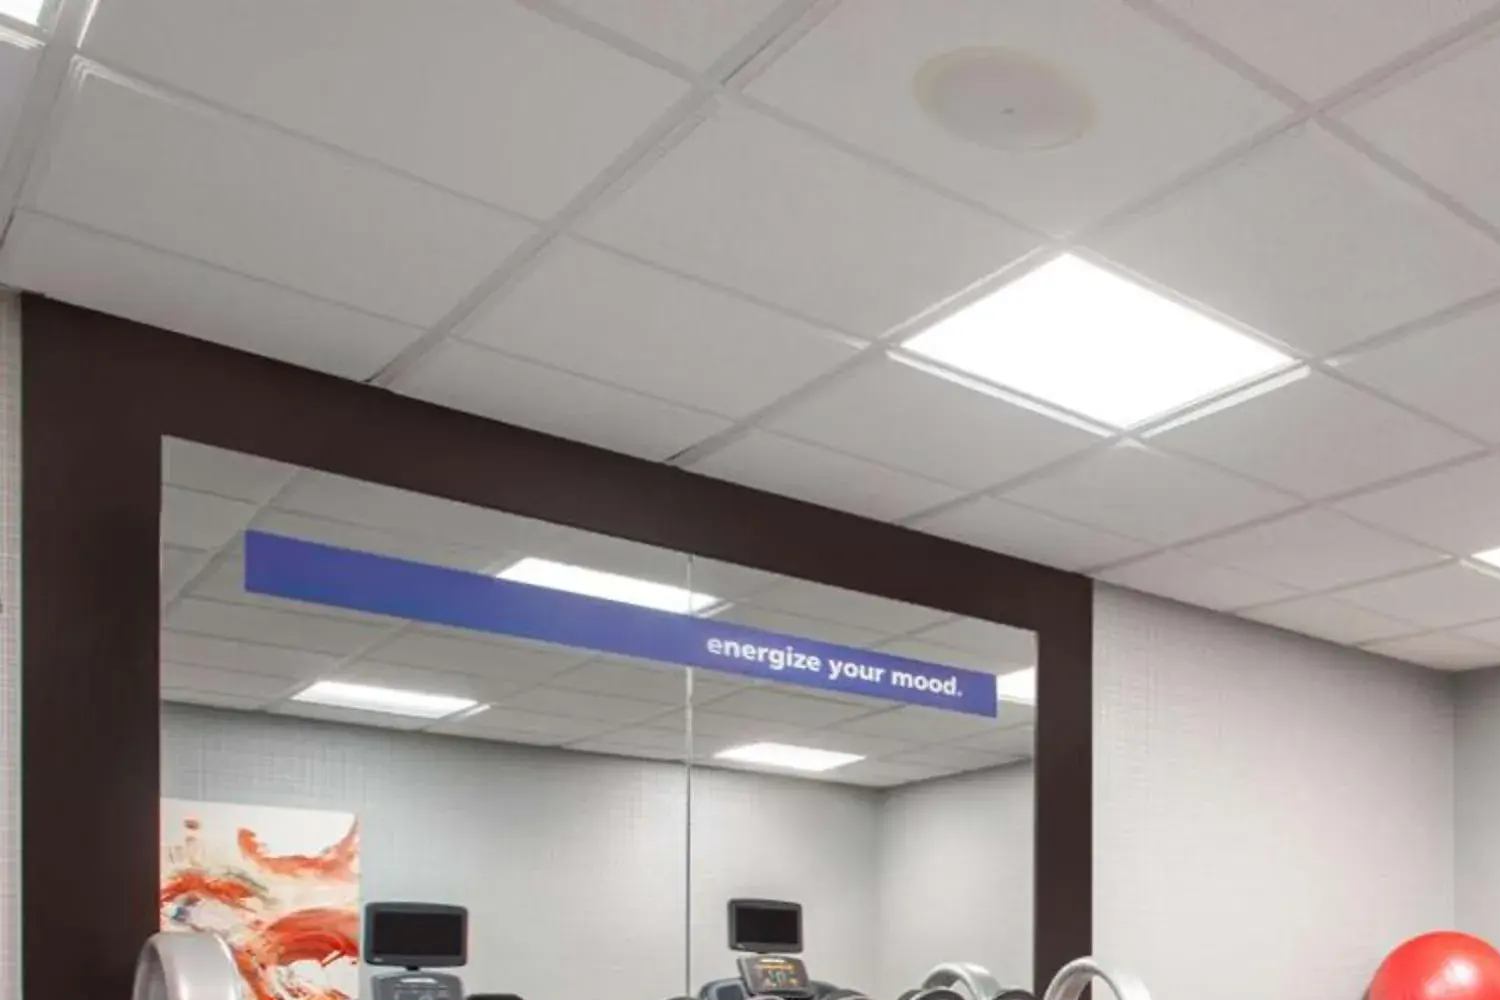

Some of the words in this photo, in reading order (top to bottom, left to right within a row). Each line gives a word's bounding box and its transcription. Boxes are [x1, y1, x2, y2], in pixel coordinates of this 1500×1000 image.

[706, 637, 821, 672] energize
[828, 660, 885, 682] your
[891, 671, 963, 697] mood.
